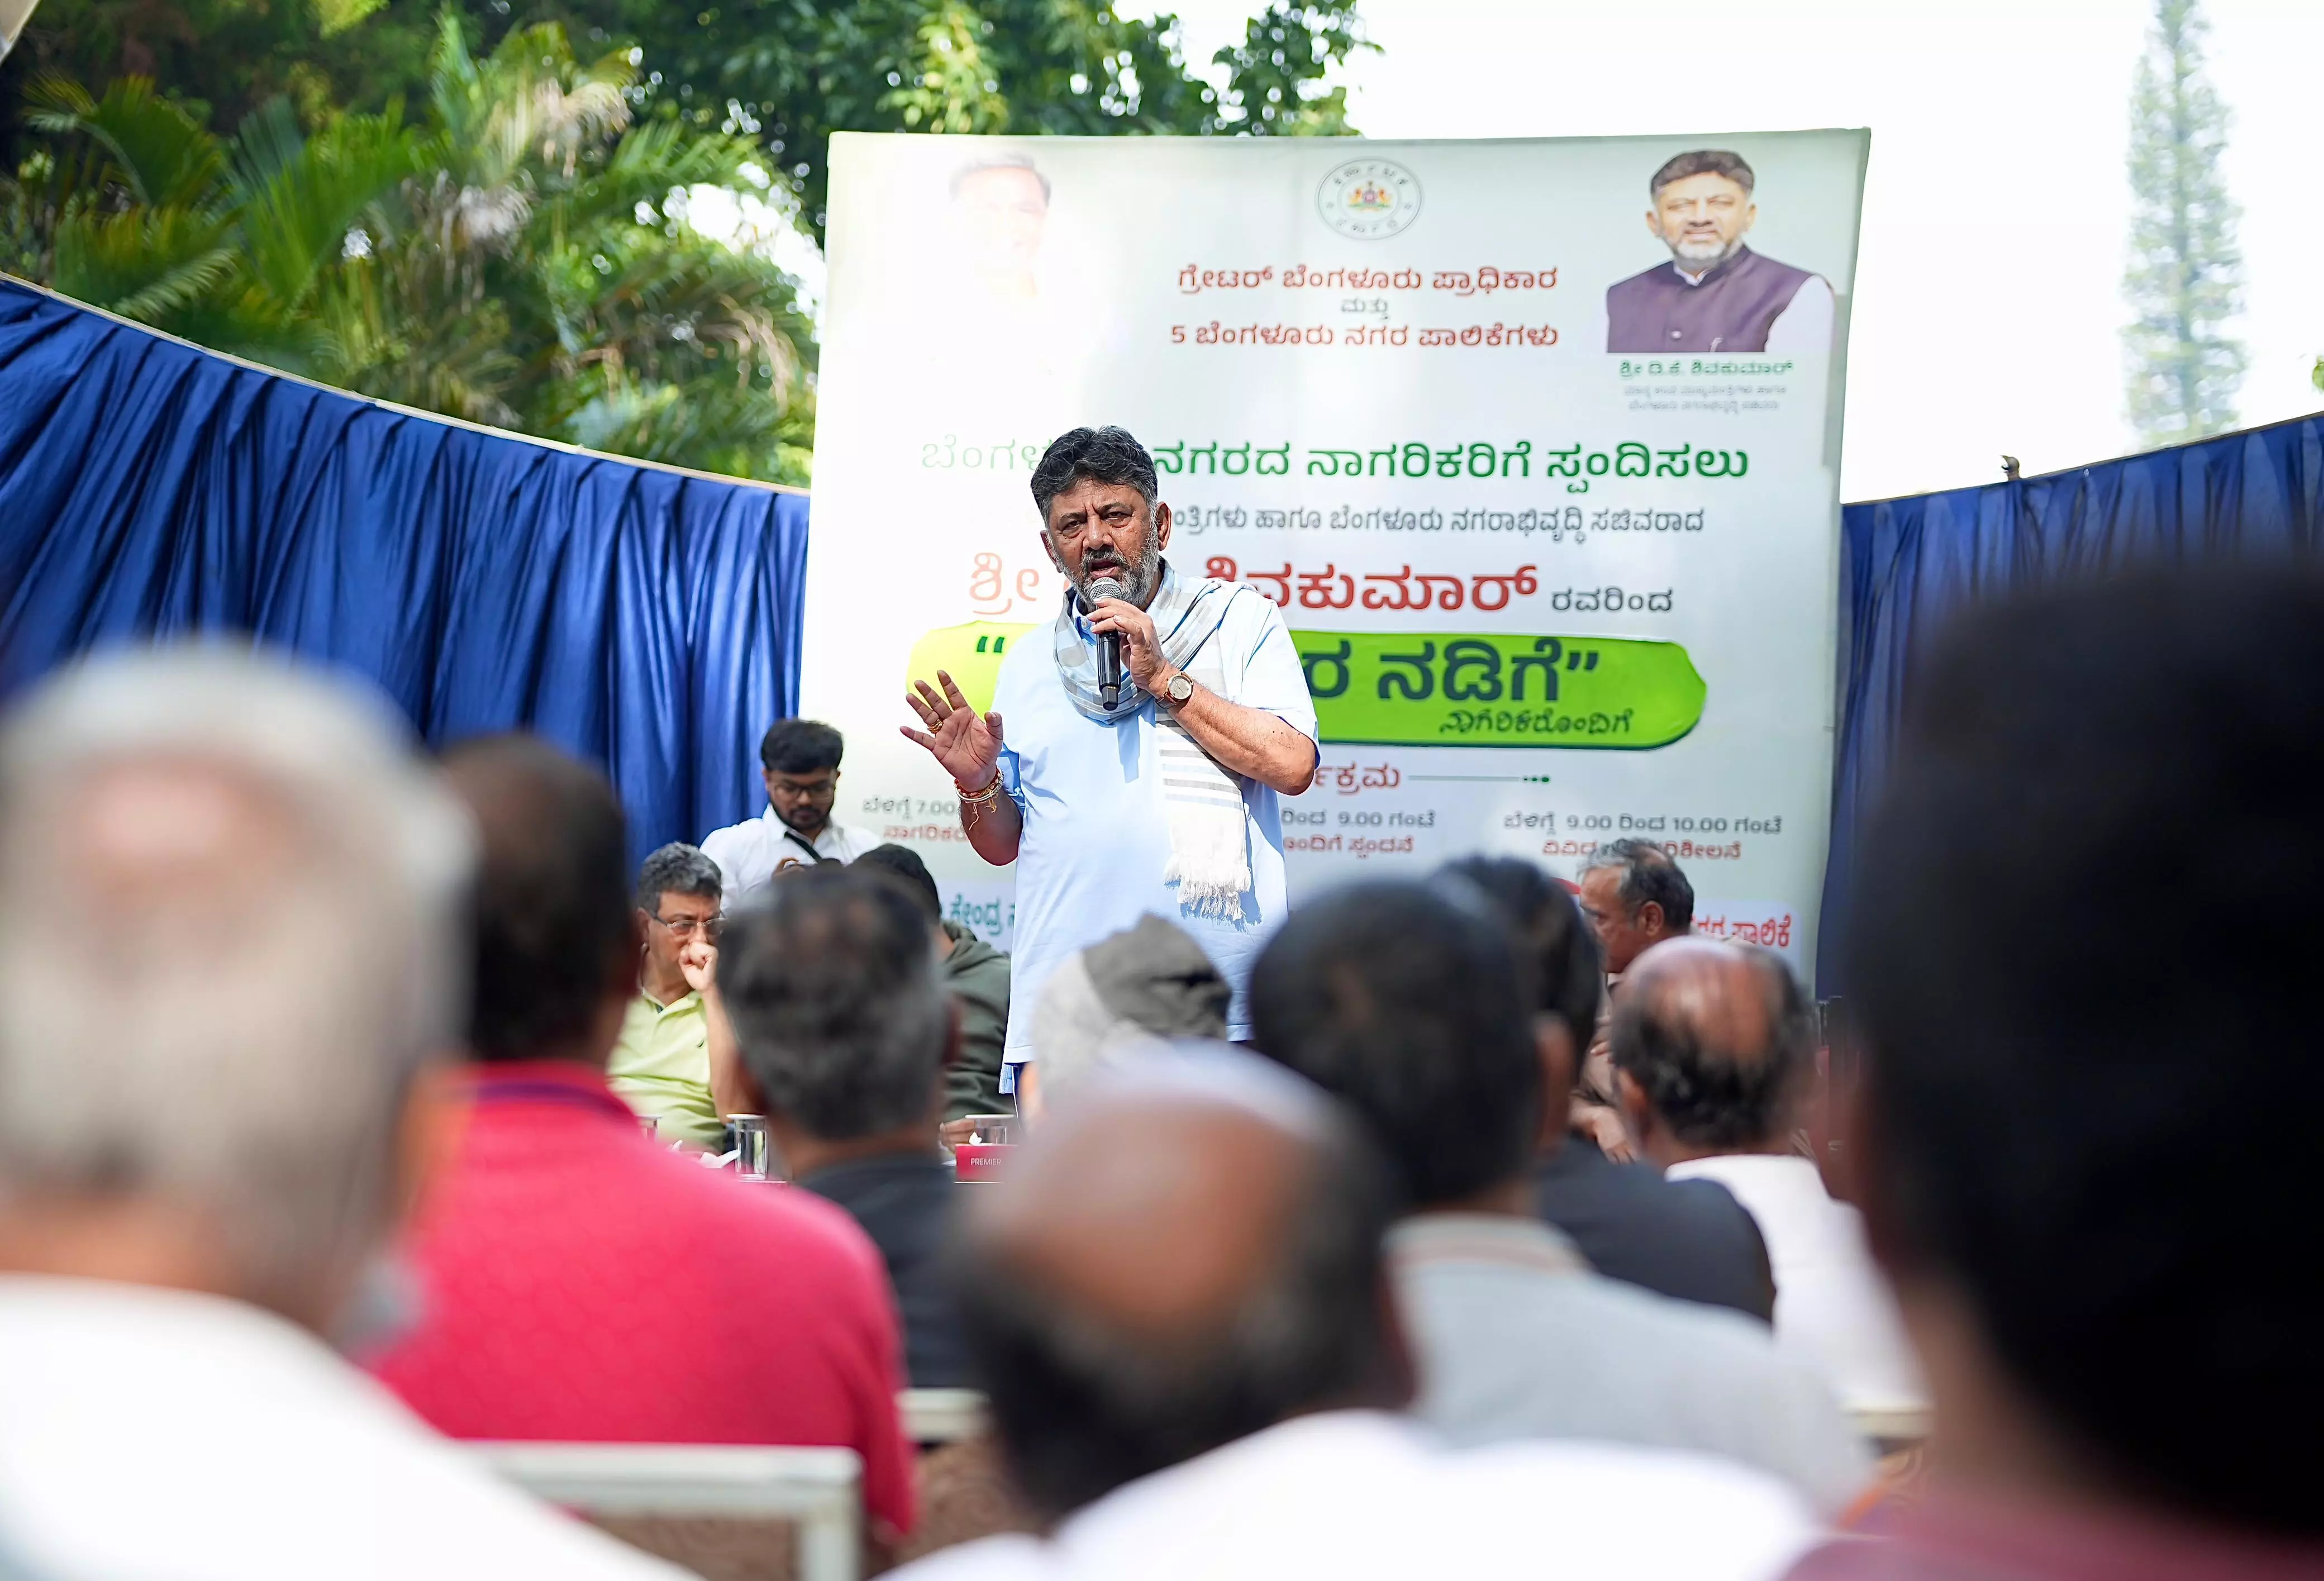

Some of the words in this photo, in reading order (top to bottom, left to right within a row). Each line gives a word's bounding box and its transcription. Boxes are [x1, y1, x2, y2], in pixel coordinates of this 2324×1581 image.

[1179, 263, 1273, 294] ಗ್ರೇಟರ್
[1282, 264, 1421, 289] ಬೆಂಗಳೂರು
[1432, 266, 1558, 296] ಪ್ರಾಧಿಕಾರ
[1171, 325, 1185, 344] 5
[1196, 321, 1333, 344] ಬೆಂಗಳೂರು
[1345, 325, 1408, 345] ನಗರ
[1419, 322, 1558, 345] ಪಾಲಿಕೆಗಳು
[1153, 441, 1290, 475] ನಗರದ
[1307, 440, 1531, 478] ನಾಗರಿಕರಿಗೆ
[1547, 441, 1749, 493] ಸ್ಪಂದಿಸಲು
[1256, 505, 1321, 528] ಹಾಗೂ
[1330, 505, 1442, 530] ಬೆಂಗಳೂರು
[1590, 507, 1704, 532] ಸಚಿವರಾದ
[969, 552, 1040, 615] ಶ್ರೀ
[1551, 586, 1673, 613] ರವರಿಂದ
[1566, 815, 1612, 831] 9.00
[1673, 817, 1728, 833] 10.00
[970, 1158, 1001, 1166] PREMIER
